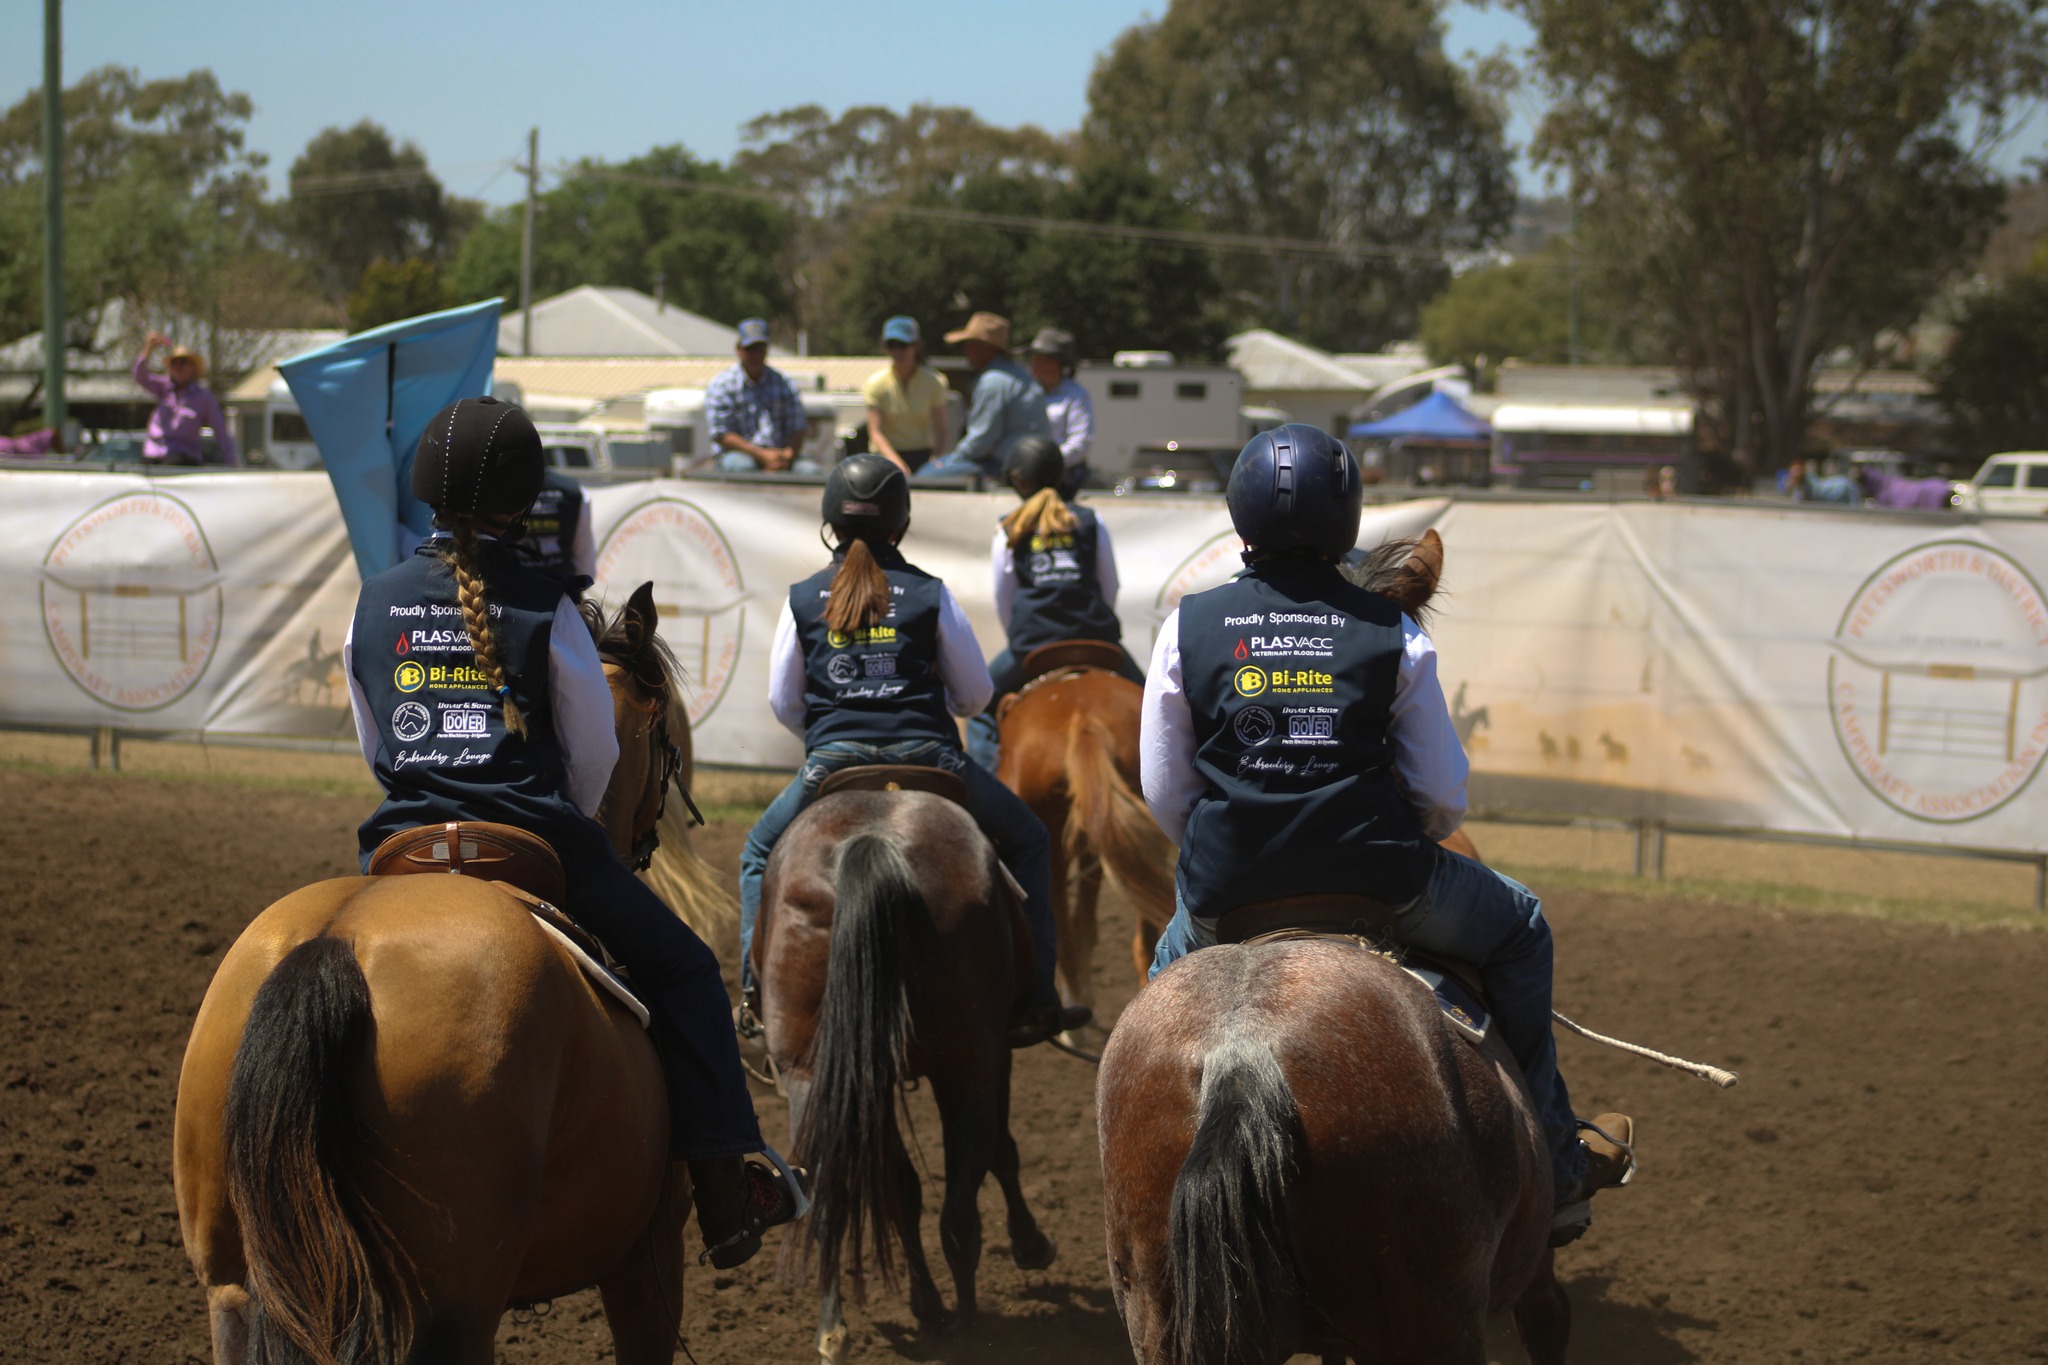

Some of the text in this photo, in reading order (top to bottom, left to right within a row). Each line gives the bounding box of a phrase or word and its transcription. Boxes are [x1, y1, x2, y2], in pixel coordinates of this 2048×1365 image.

[389, 604, 502, 618] Proudly Spons By
[1225, 612, 1345, 628] Proudly Sponsored By
[412, 630, 471, 643] PLASVA
[1251, 636, 1333, 649] PLASVACC
[430, 666, 487, 681] Bi-Rite
[1272, 670, 1332, 686] Bi-Rite
[1308, 706, 1316, 714] &
[446, 710, 484, 730] DOVER
[1292, 715, 1329, 736] DOVER
[453, 748, 491, 766] Lounge
[1300, 755, 1339, 775] Lounge
